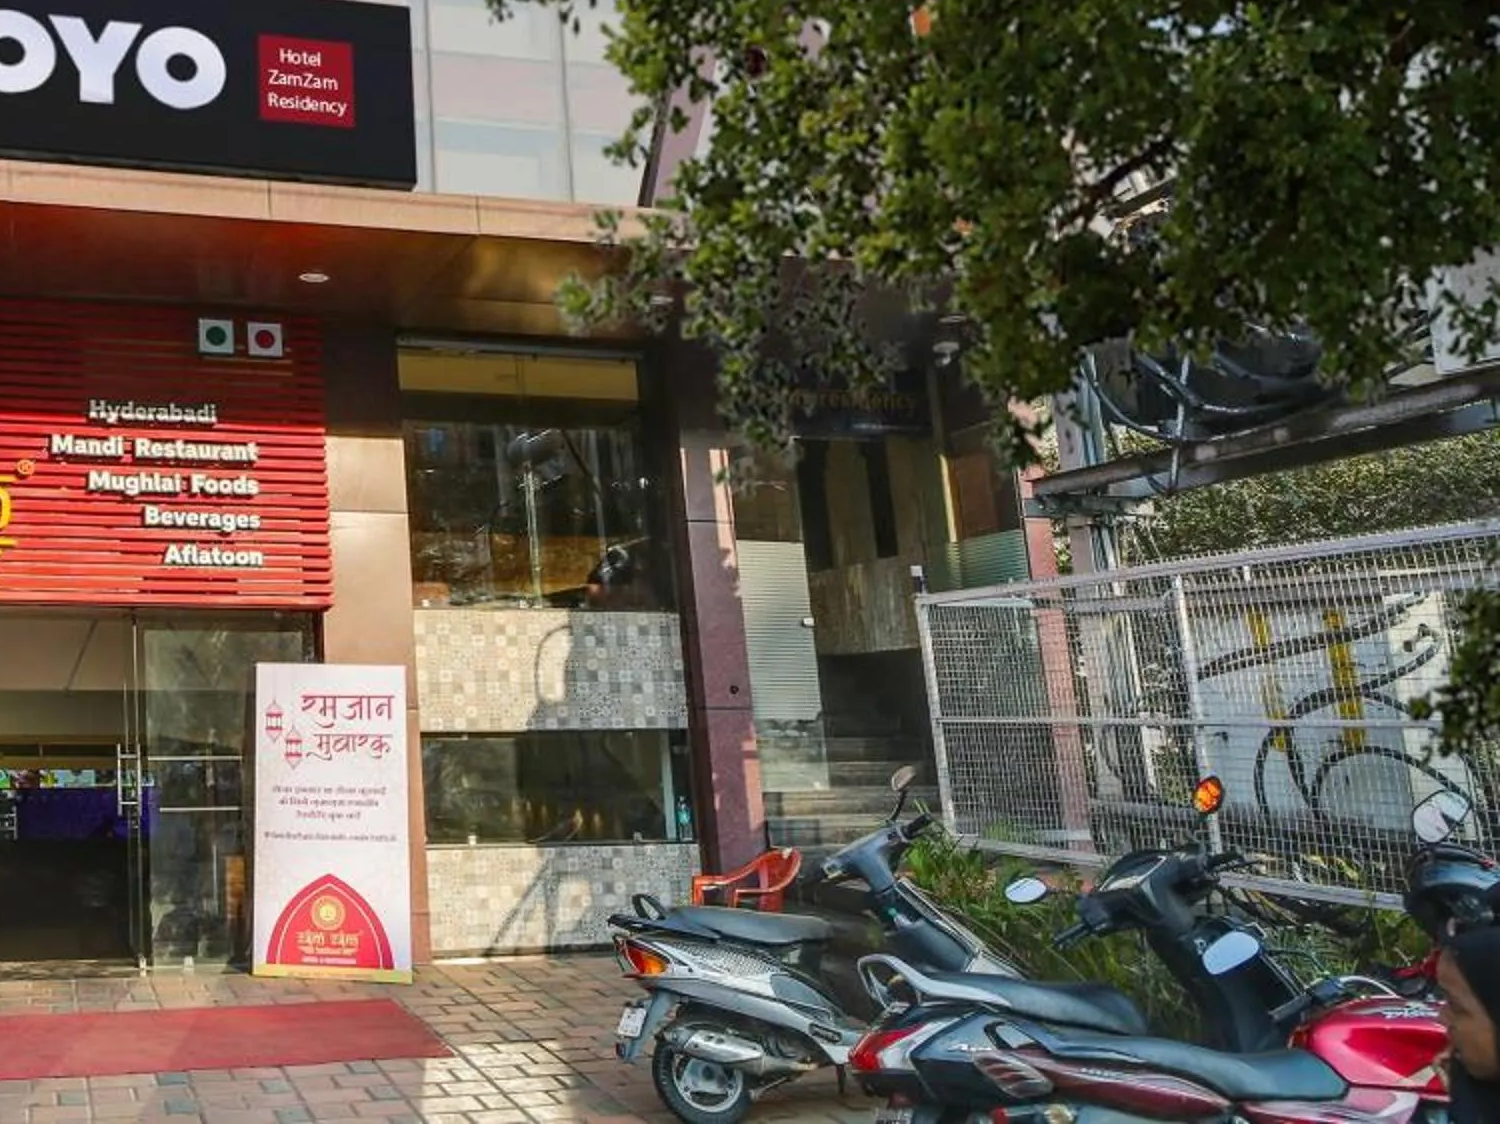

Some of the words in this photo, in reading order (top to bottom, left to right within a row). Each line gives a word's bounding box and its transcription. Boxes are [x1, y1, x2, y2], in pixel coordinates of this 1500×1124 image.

[279, 48, 321, 67] Hotel
[268, 69, 339, 90] ZamZam
[267, 92, 348, 117] Residency
[88, 399, 218, 423] Hyderabadi
[51, 434, 125, 456] Mandi
[134, 438, 260, 460] Restaurant
[87, 470, 182, 495] Mughlai
[190, 474, 260, 495] Foods
[143, 506, 261, 531] Beverages
[163, 543, 264, 565] Aflatoon
